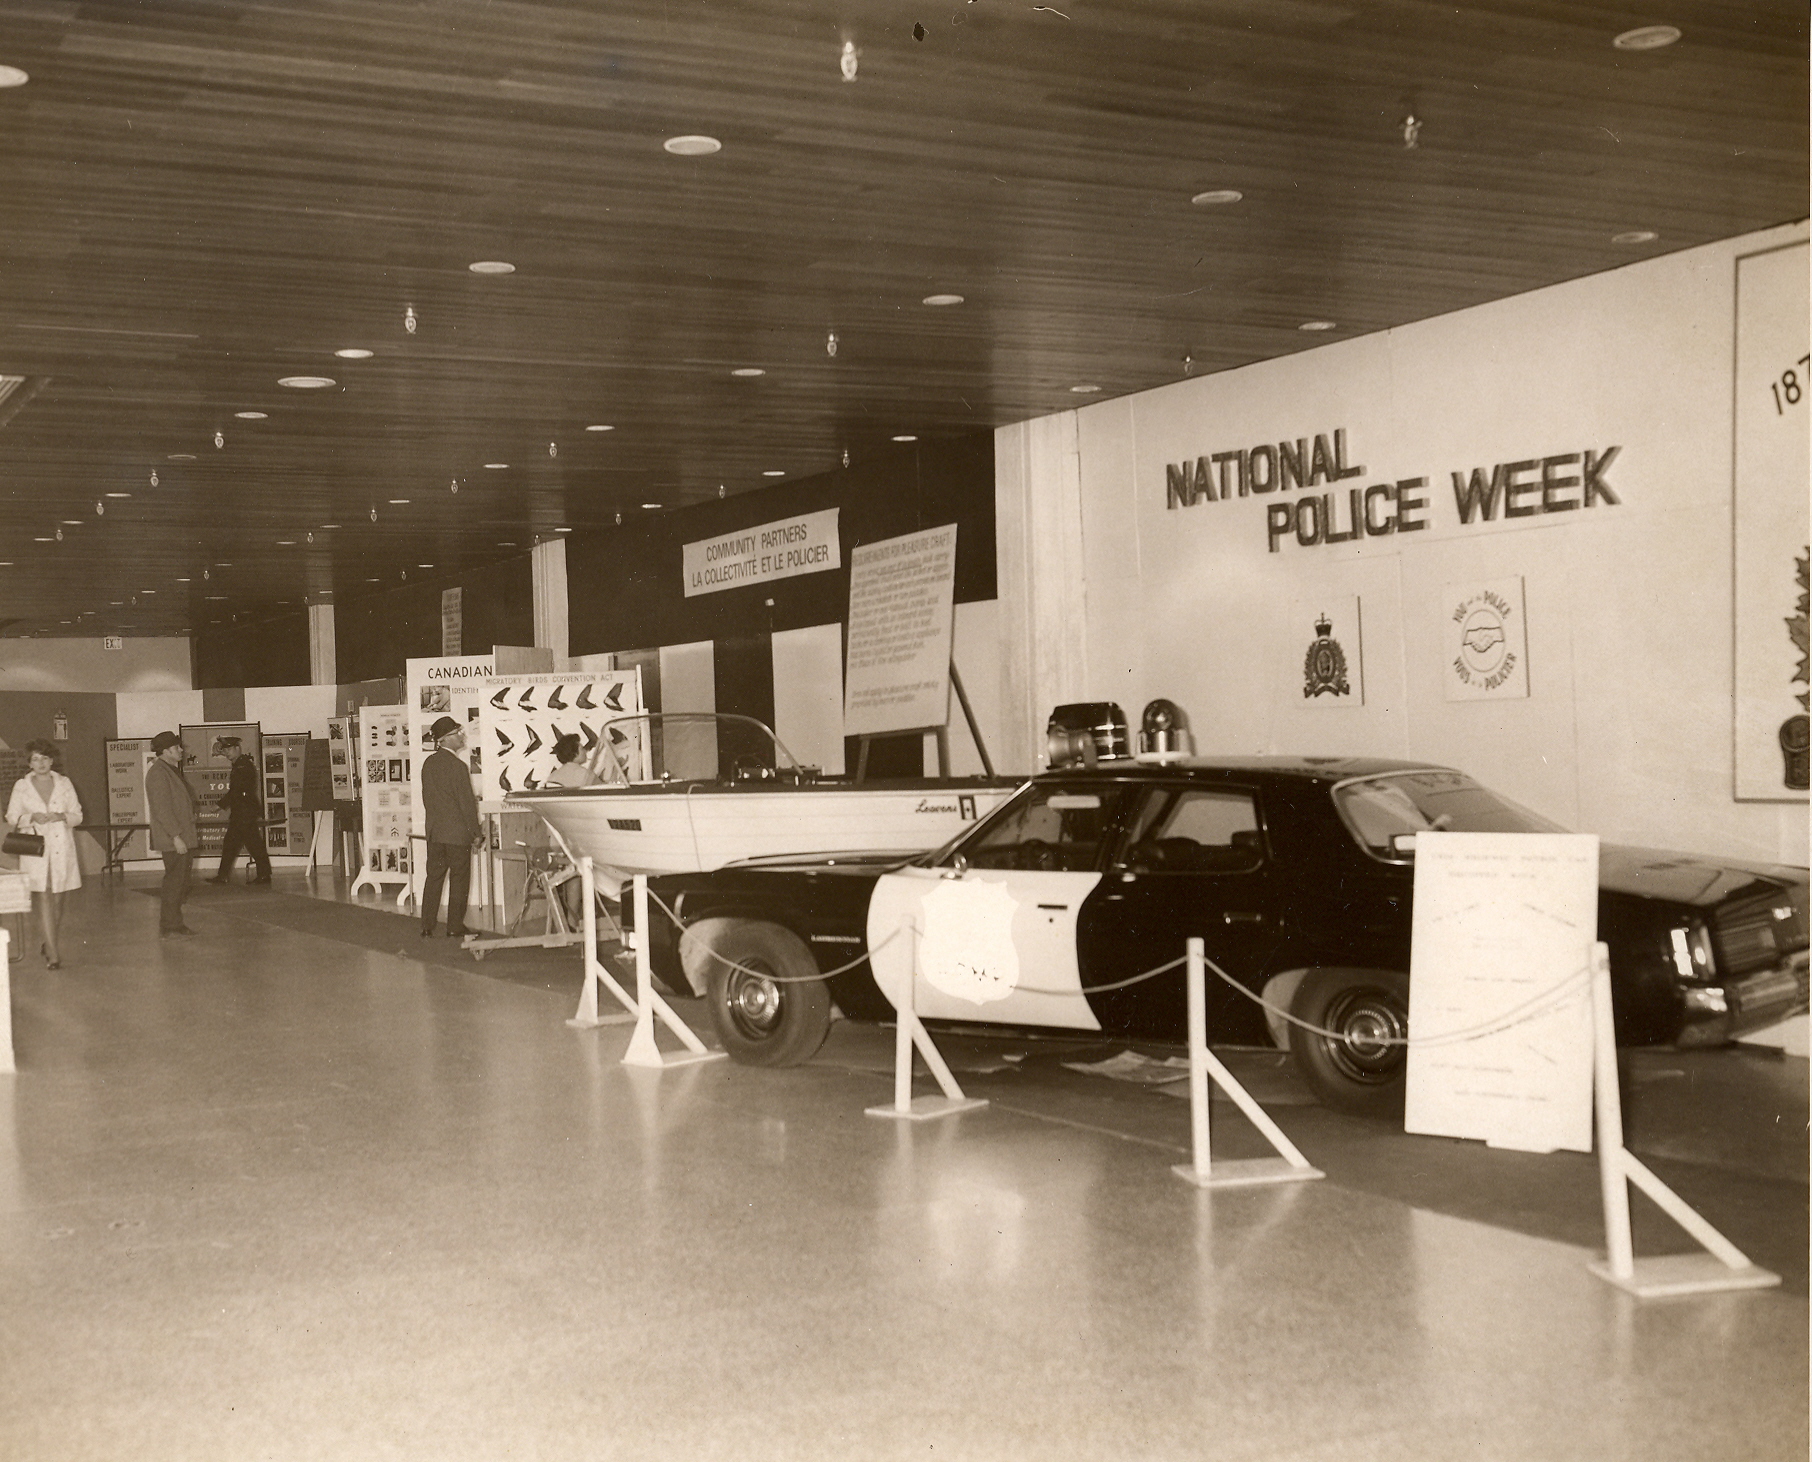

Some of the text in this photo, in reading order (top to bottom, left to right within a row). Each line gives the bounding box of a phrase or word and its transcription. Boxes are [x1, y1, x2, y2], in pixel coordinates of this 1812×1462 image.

[1166, 428, 1367, 510] NATIONAL
[1267, 445, 1624, 553] POLICE WEEK
[706, 524, 807, 562] COMMUNITY PARTNERS
[692, 544, 829, 588] LA COLLECTIVITÉ ET LE POLICIER
[427, 665, 493, 679] CANADIAN
[485, 678, 522, 686] MIGRATORY
[552, 675, 596, 683] CONVENTION
[600, 674, 613, 682] ACT
[109, 743, 140, 752] SPECIALIST
